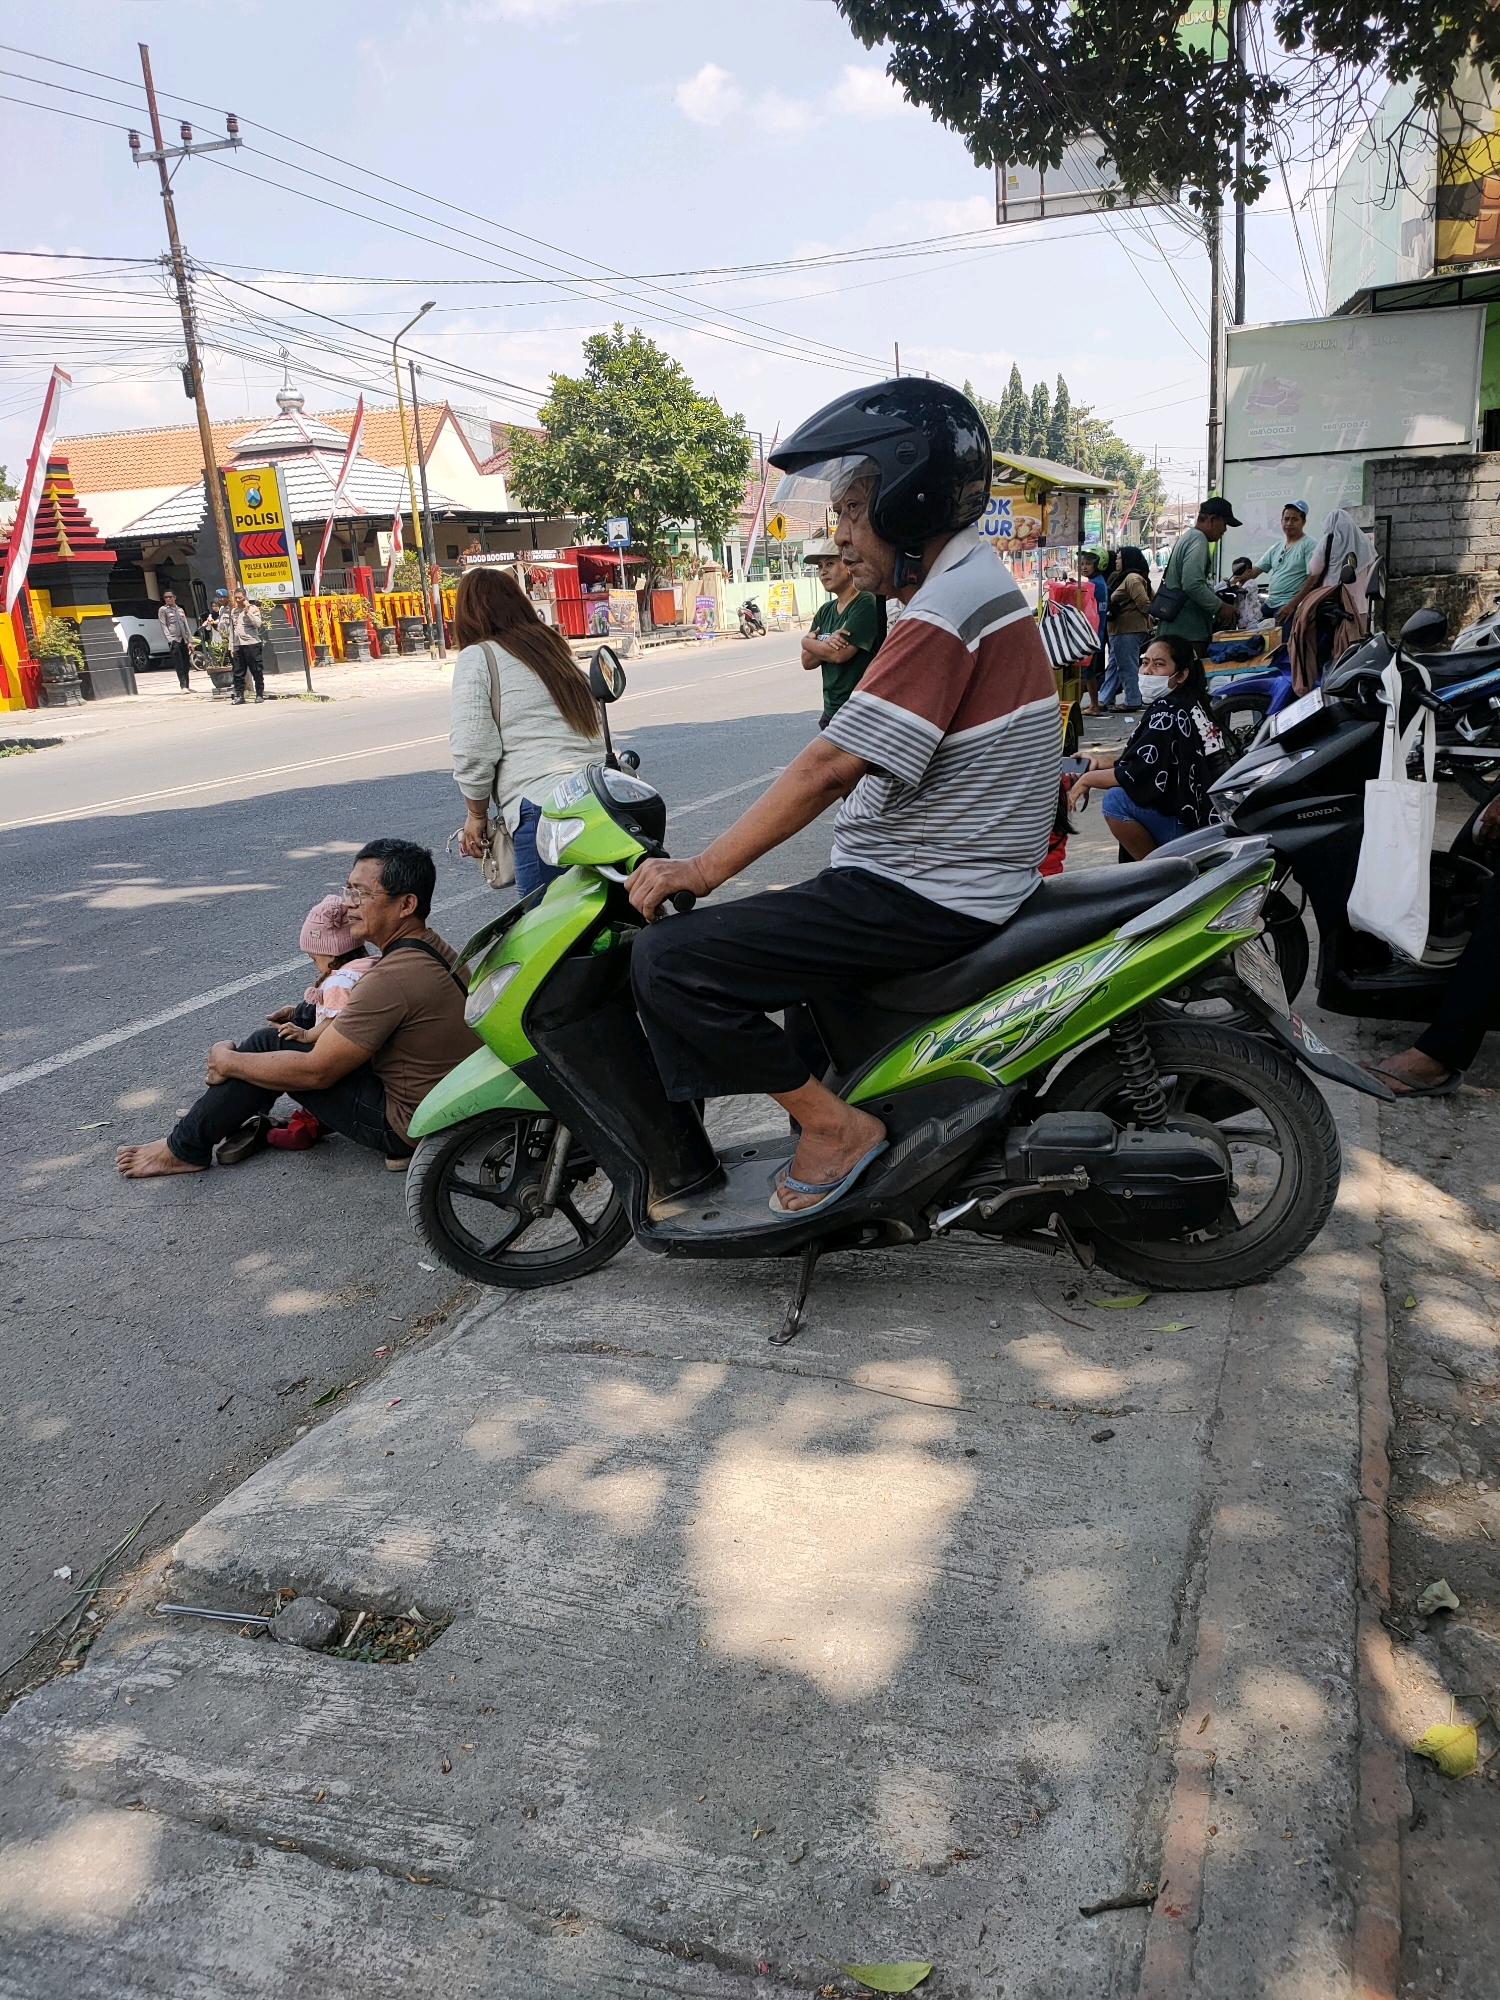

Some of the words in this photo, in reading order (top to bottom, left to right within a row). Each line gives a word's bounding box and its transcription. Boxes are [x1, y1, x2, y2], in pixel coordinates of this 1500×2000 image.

[984, 498, 1011, 516] OK
[235, 512, 279, 527] POLISI
[975, 519, 1012, 537] LUR
[467, 554, 486, 564] MOOD
[487, 552, 515, 562] BOOSTER
[244, 562, 262, 571] POLSEK
[1296, 806, 1342, 820] HONDA
